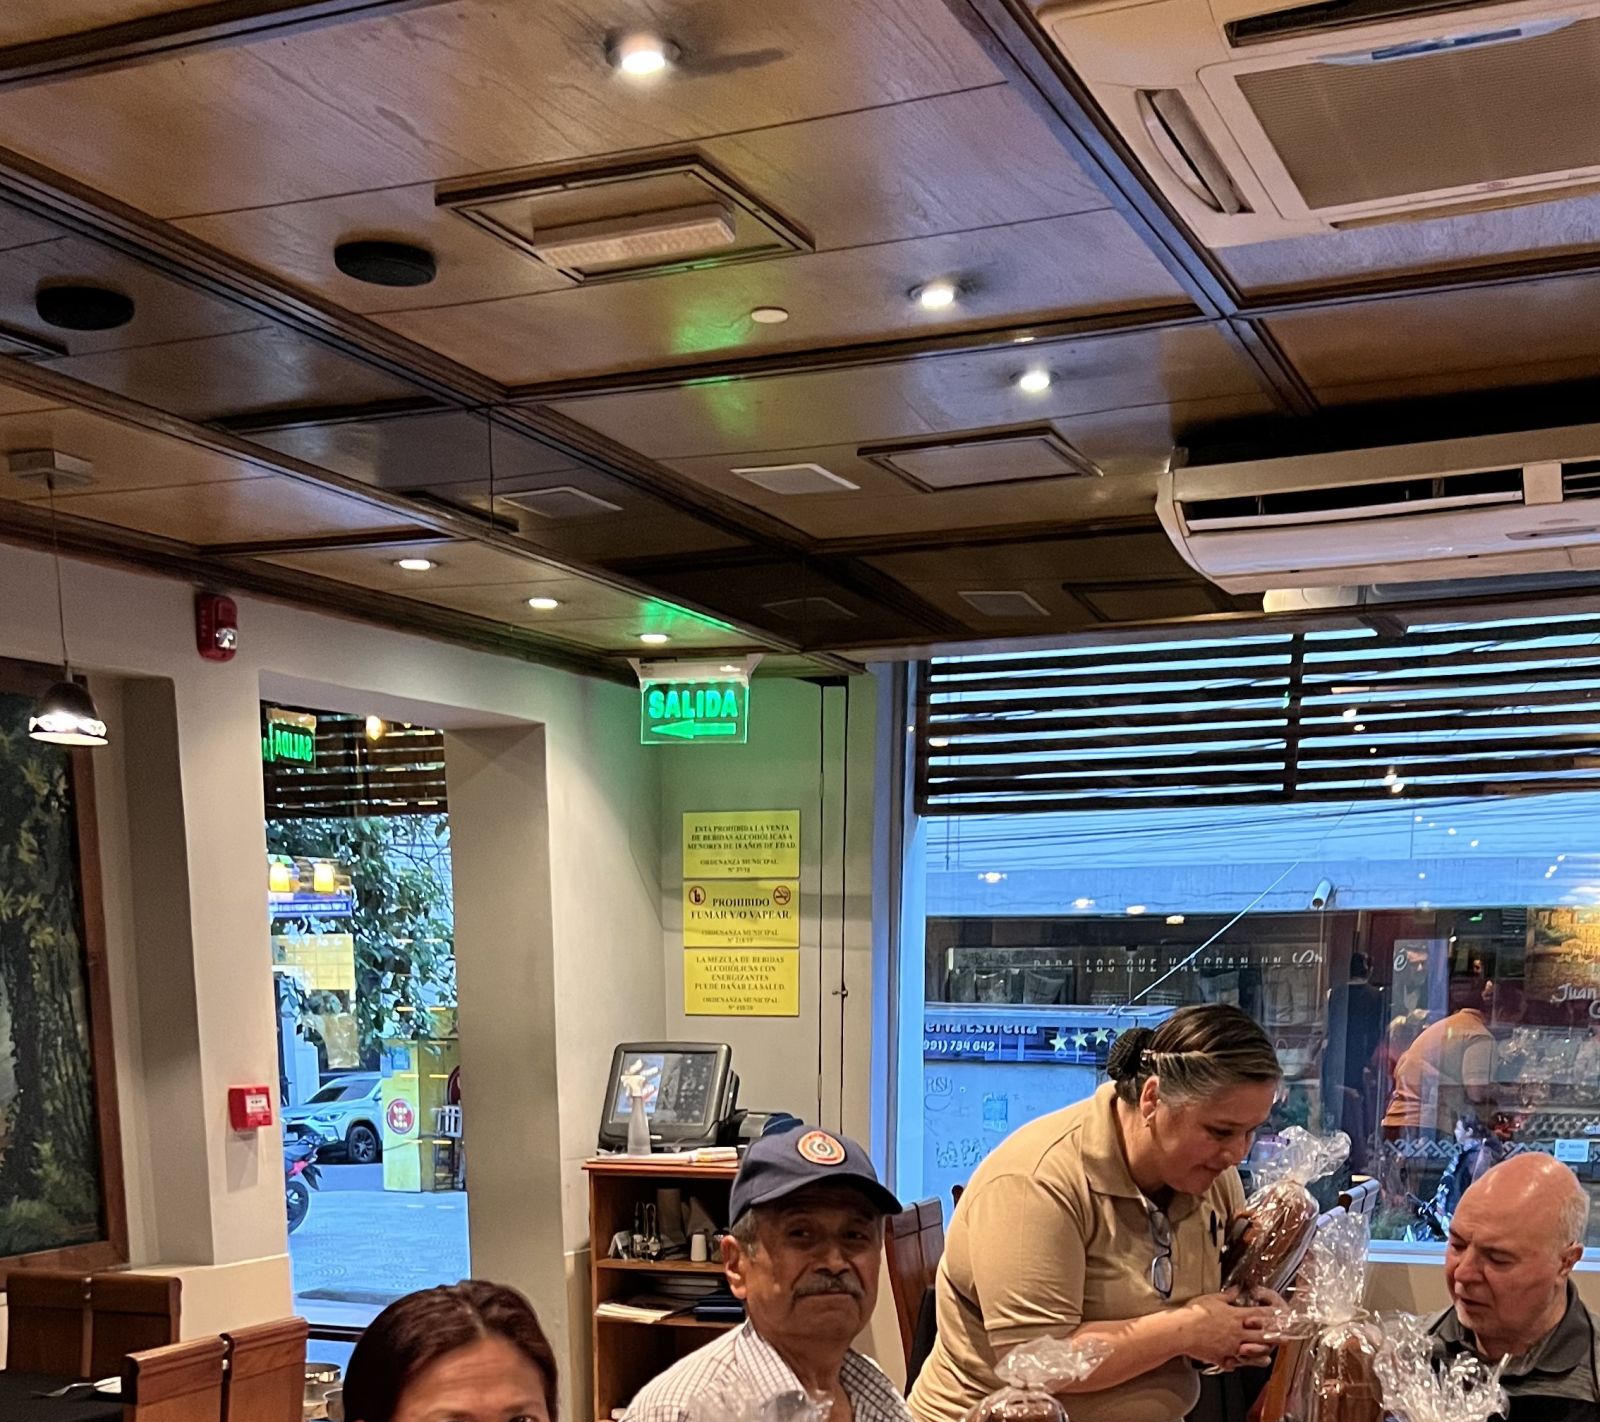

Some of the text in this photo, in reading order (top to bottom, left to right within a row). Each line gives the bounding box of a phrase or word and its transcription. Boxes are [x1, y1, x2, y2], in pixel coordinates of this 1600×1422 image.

[648, 689, 738, 718] SALIDA
[712, 898, 770, 907] PROHIBIDO
[691, 910, 727, 920] FUMAR
[730, 910, 747, 920] Y/O
[1086, 959, 1116, 973] LOS
[1126, 958, 1157, 972] QUE
[1551, 982, 1597, 1003] Juan
